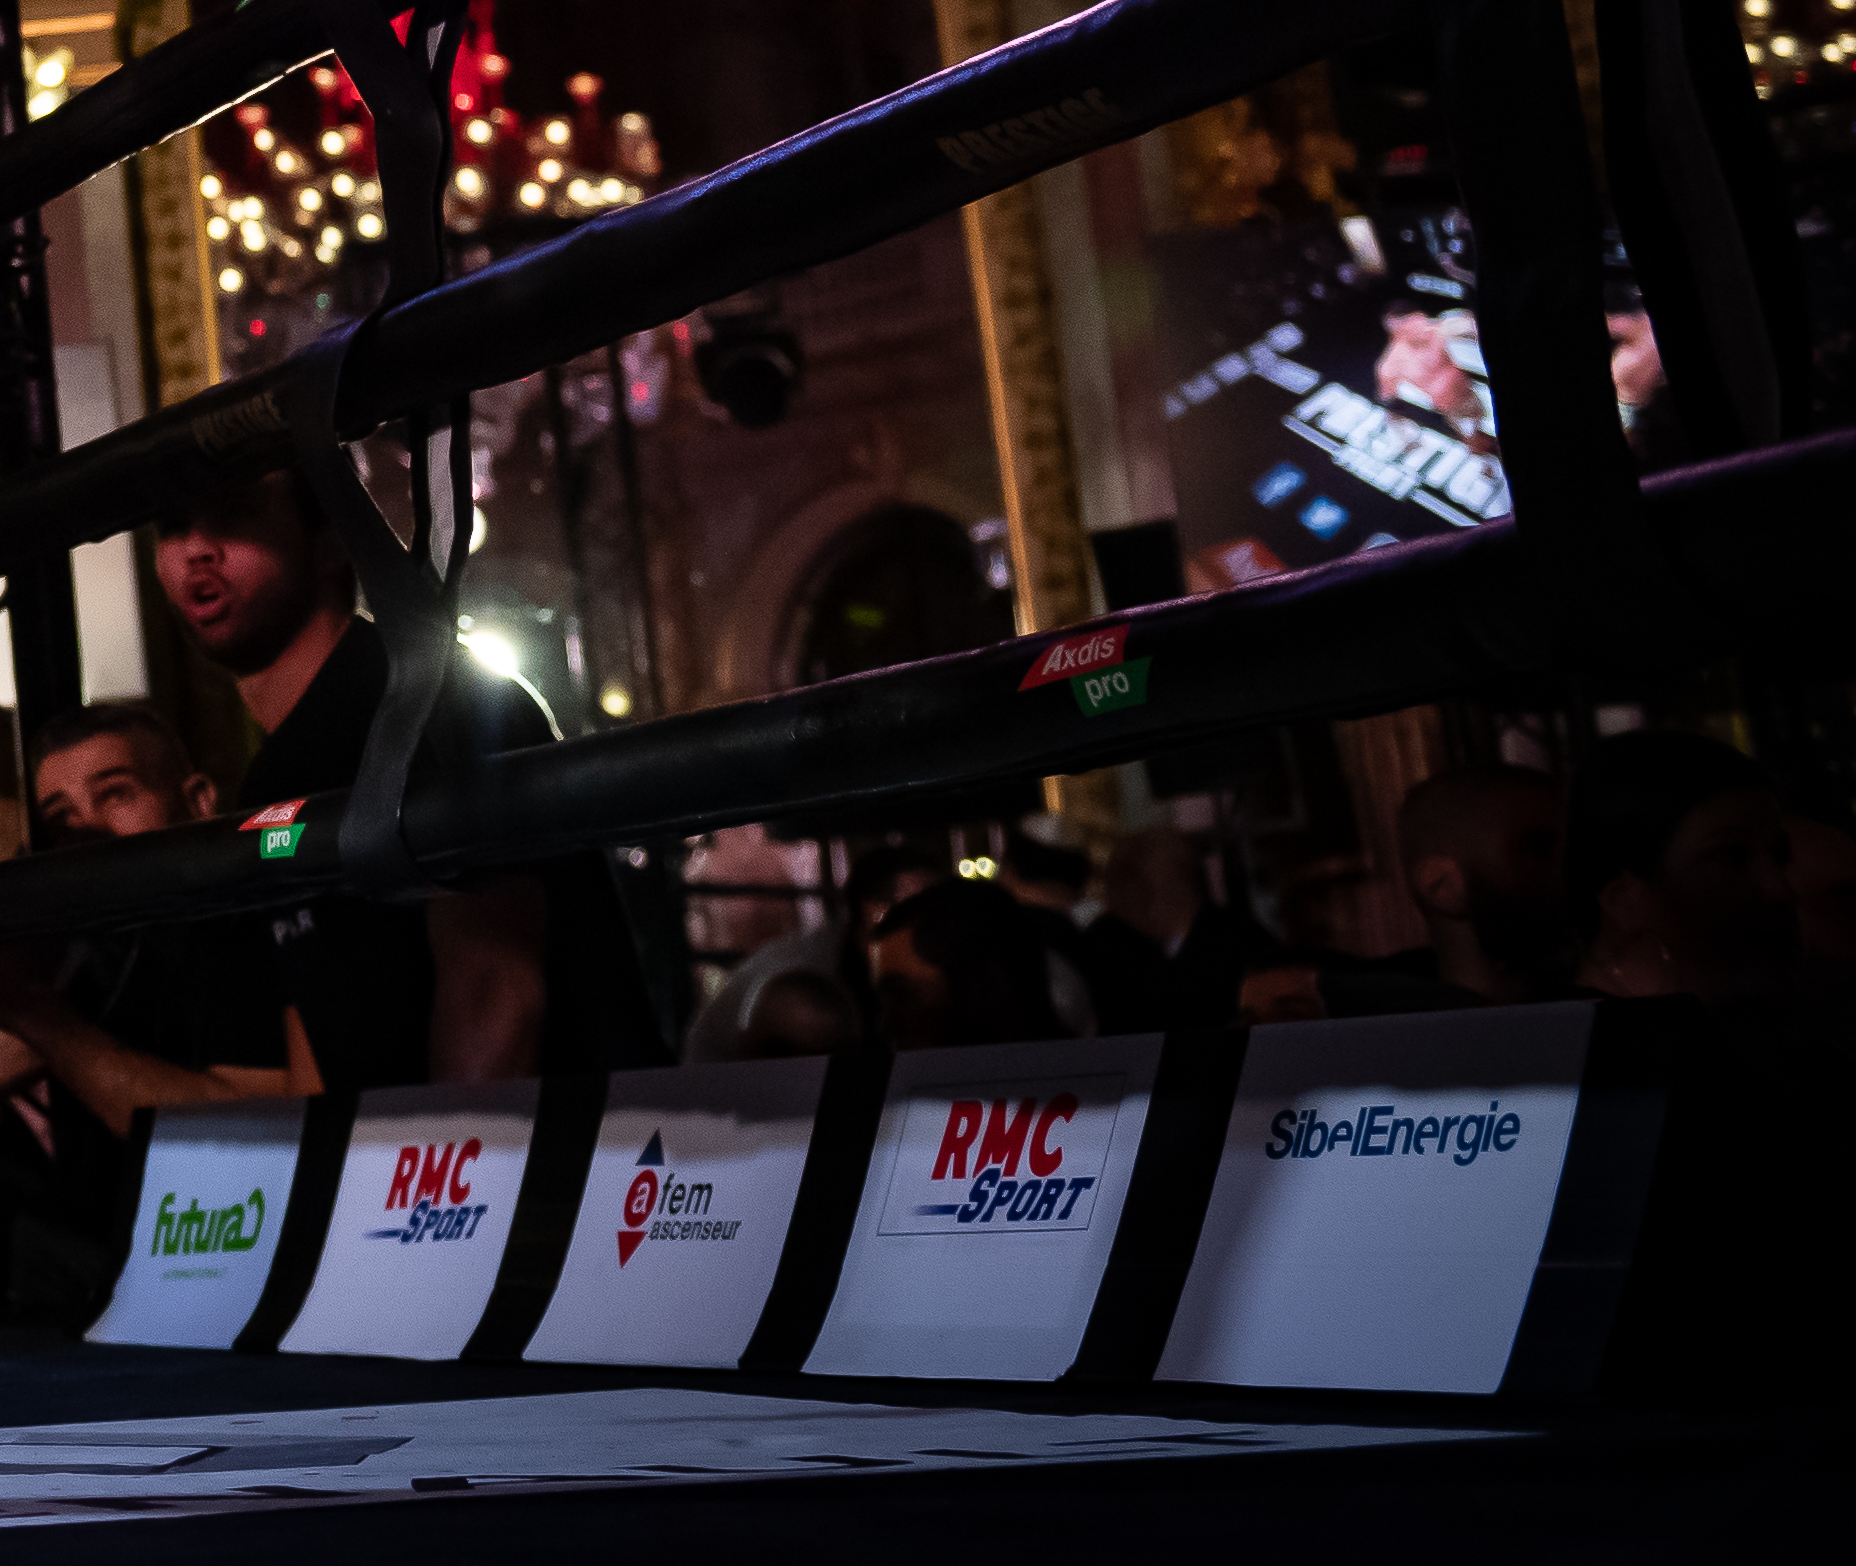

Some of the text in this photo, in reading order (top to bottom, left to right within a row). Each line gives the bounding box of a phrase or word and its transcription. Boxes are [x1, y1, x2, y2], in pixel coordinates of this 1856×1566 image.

[1041, 635, 1117, 676] Axdis
[1084, 671, 1130, 709] pro
[266, 830, 291, 853] pro
[931, 1092, 1078, 1180] RMC
[1265, 1100, 1521, 1166] SibelEnergie
[385, 1138, 481, 1210] RMC
[957, 1168, 1096, 1223] SPORT
[400, 1200, 488, 1243] SPORT
[648, 1219, 742, 1241] ascenseur
